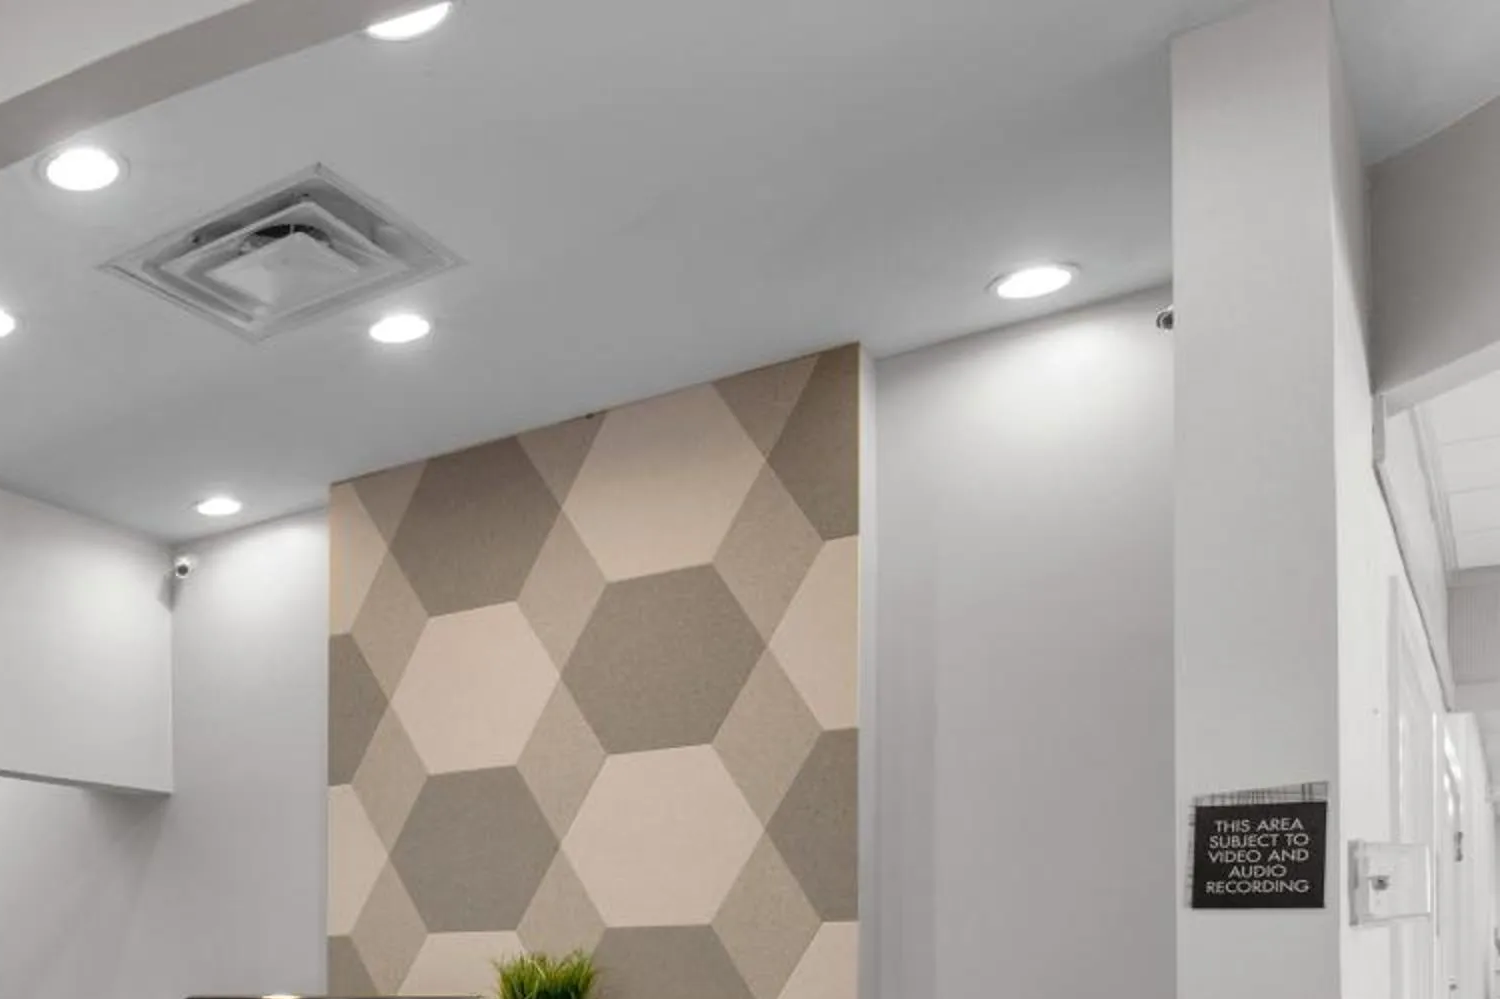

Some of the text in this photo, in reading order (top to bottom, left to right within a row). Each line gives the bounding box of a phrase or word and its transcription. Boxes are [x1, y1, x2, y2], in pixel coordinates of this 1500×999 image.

[1214, 817, 1304, 833] THIS AREA
[1209, 833, 1310, 849] SUBJECT TO
[1208, 849, 1310, 863] VIDEO AND
[1228, 864, 1287, 878] AUDIO
[1205, 880, 1310, 894] RECORDING
